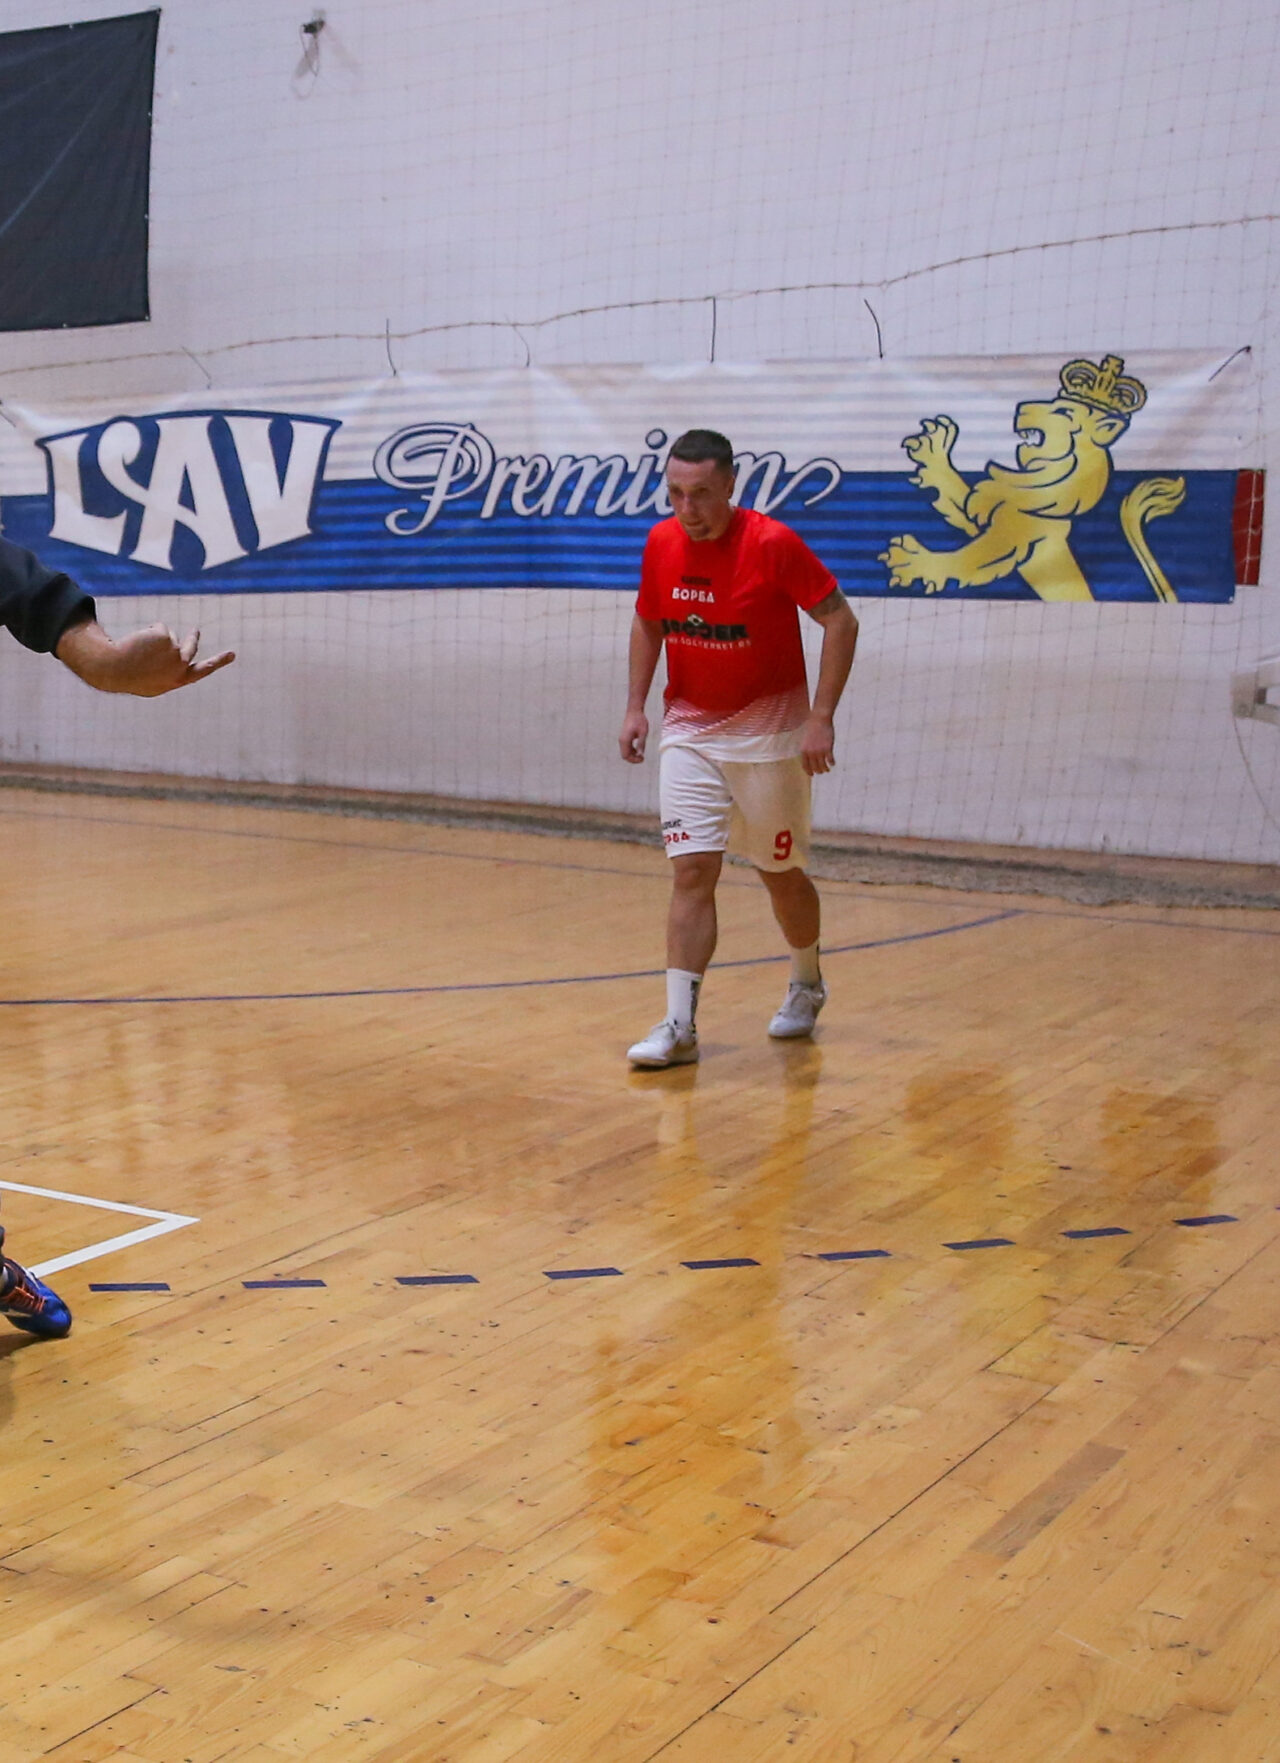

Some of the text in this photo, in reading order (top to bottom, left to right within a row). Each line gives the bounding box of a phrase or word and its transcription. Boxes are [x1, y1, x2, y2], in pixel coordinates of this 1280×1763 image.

[38, 411, 337, 572] LAV
[671, 586, 715, 604] БОРБА
[773, 829, 793, 860] 9
